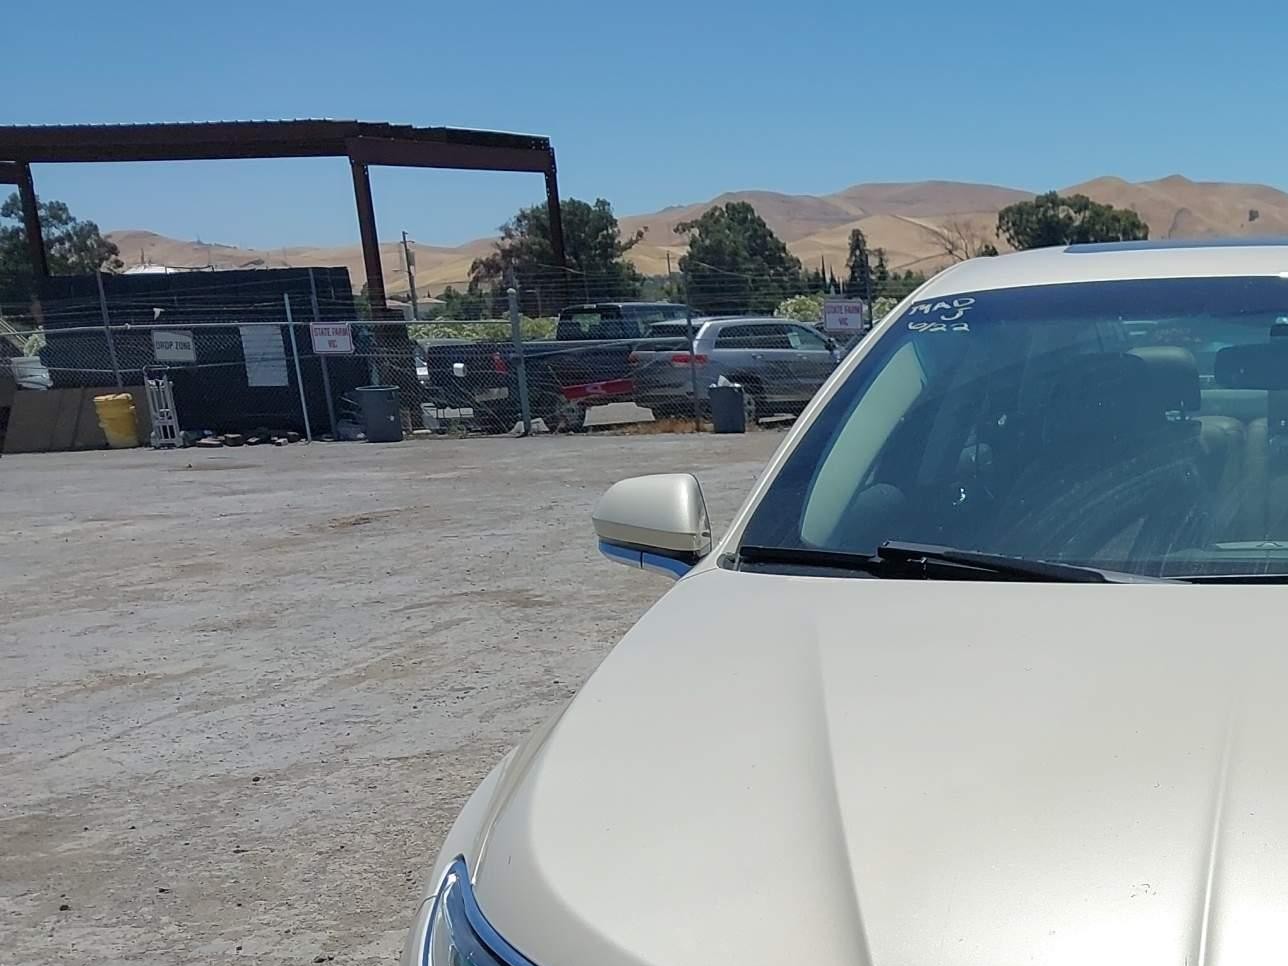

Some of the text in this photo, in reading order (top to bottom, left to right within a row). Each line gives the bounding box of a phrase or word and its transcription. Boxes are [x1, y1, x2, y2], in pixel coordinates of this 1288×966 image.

[907, 321, 971, 333] 6/22
[155, 340, 192, 351] DROP ZONE
